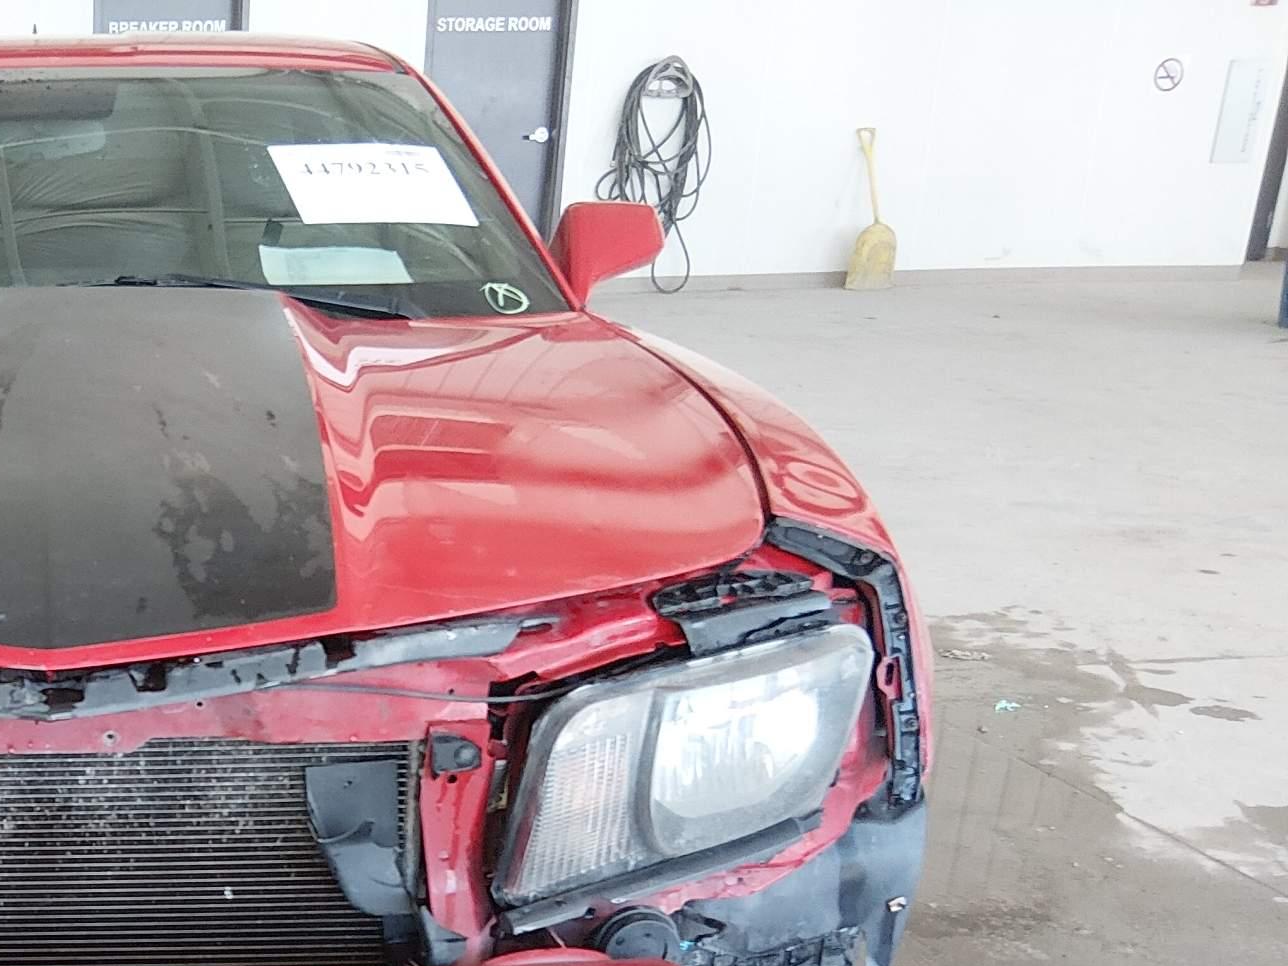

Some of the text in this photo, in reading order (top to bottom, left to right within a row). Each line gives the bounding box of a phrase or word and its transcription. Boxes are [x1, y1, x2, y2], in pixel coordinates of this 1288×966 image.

[108, 20, 227, 34] BREAKER ROOM
[436, 16, 552, 32] STORAGE ROOM
